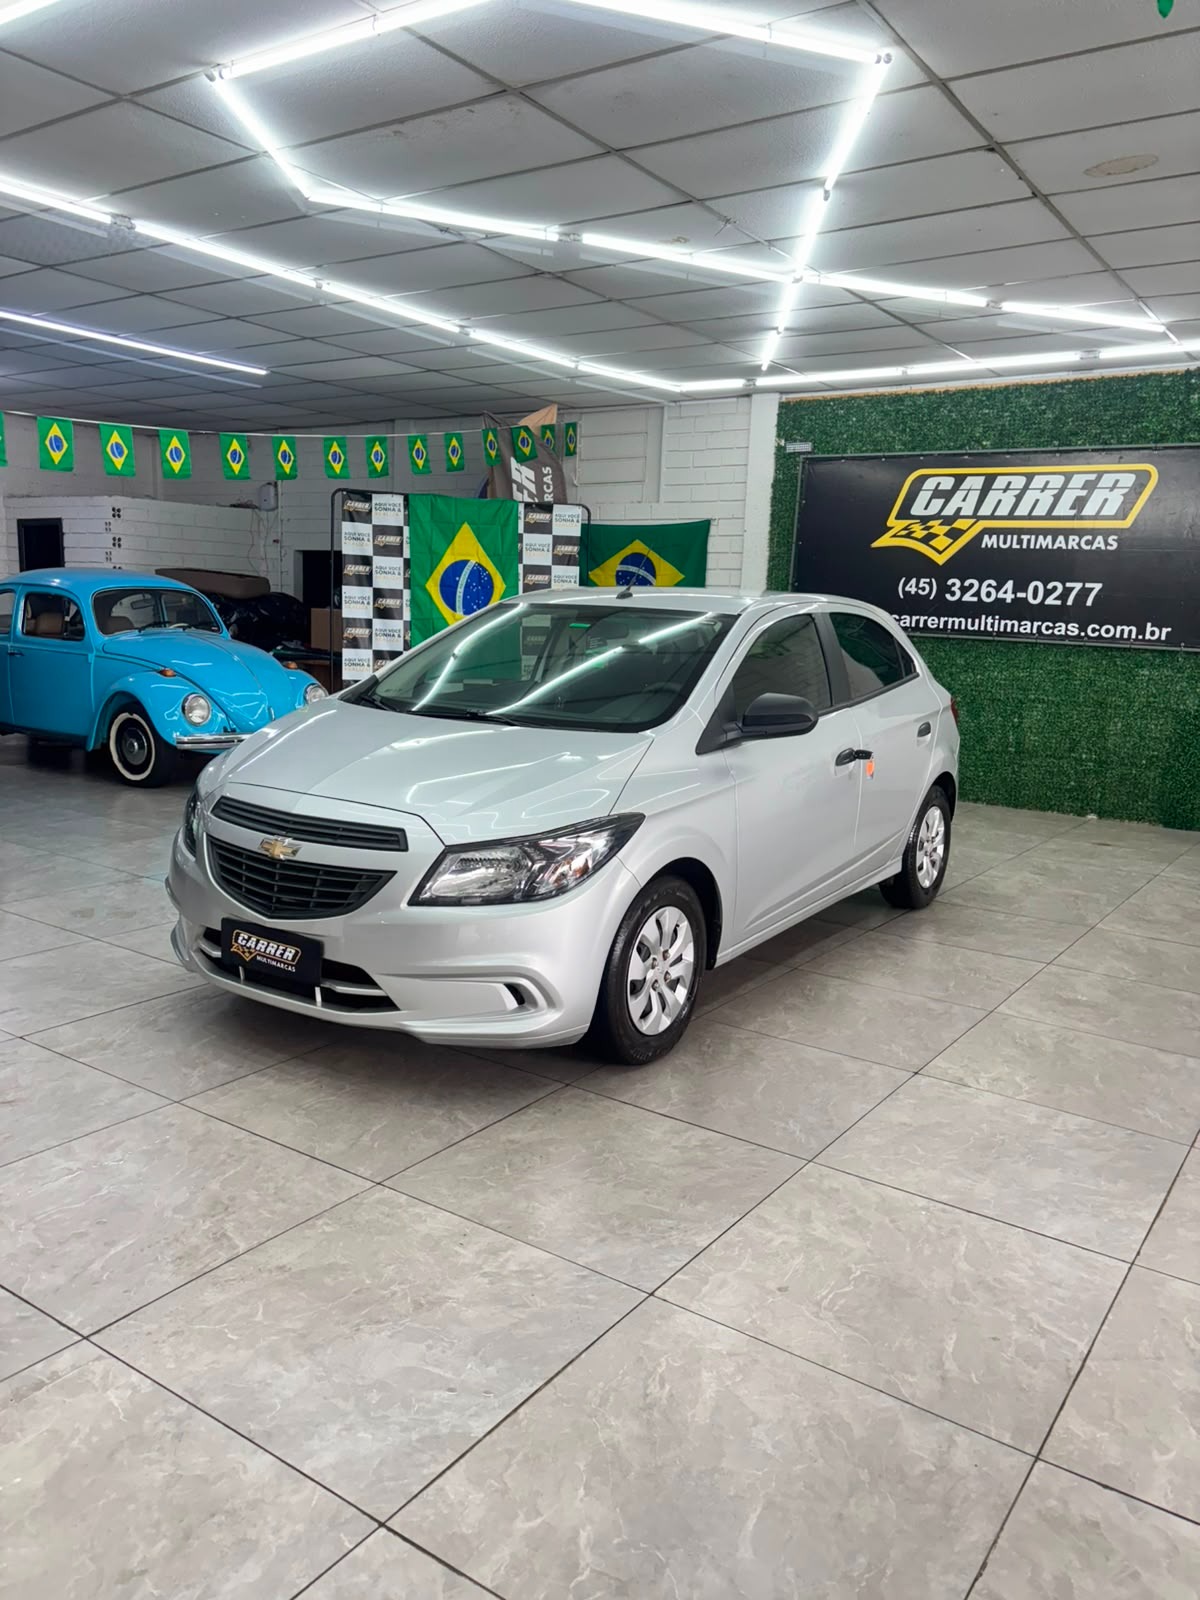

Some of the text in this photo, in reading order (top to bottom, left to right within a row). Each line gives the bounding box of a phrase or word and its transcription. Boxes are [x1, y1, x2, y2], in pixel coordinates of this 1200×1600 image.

[910, 473, 1136, 516] CARRER
[981, 534, 1118, 550] MULTIMARCAS
[898, 577, 1103, 607] (45) 3264-0277
[237, 934, 296, 960] CARRER
[256, 955, 296, 972] MULTIMARCAS
